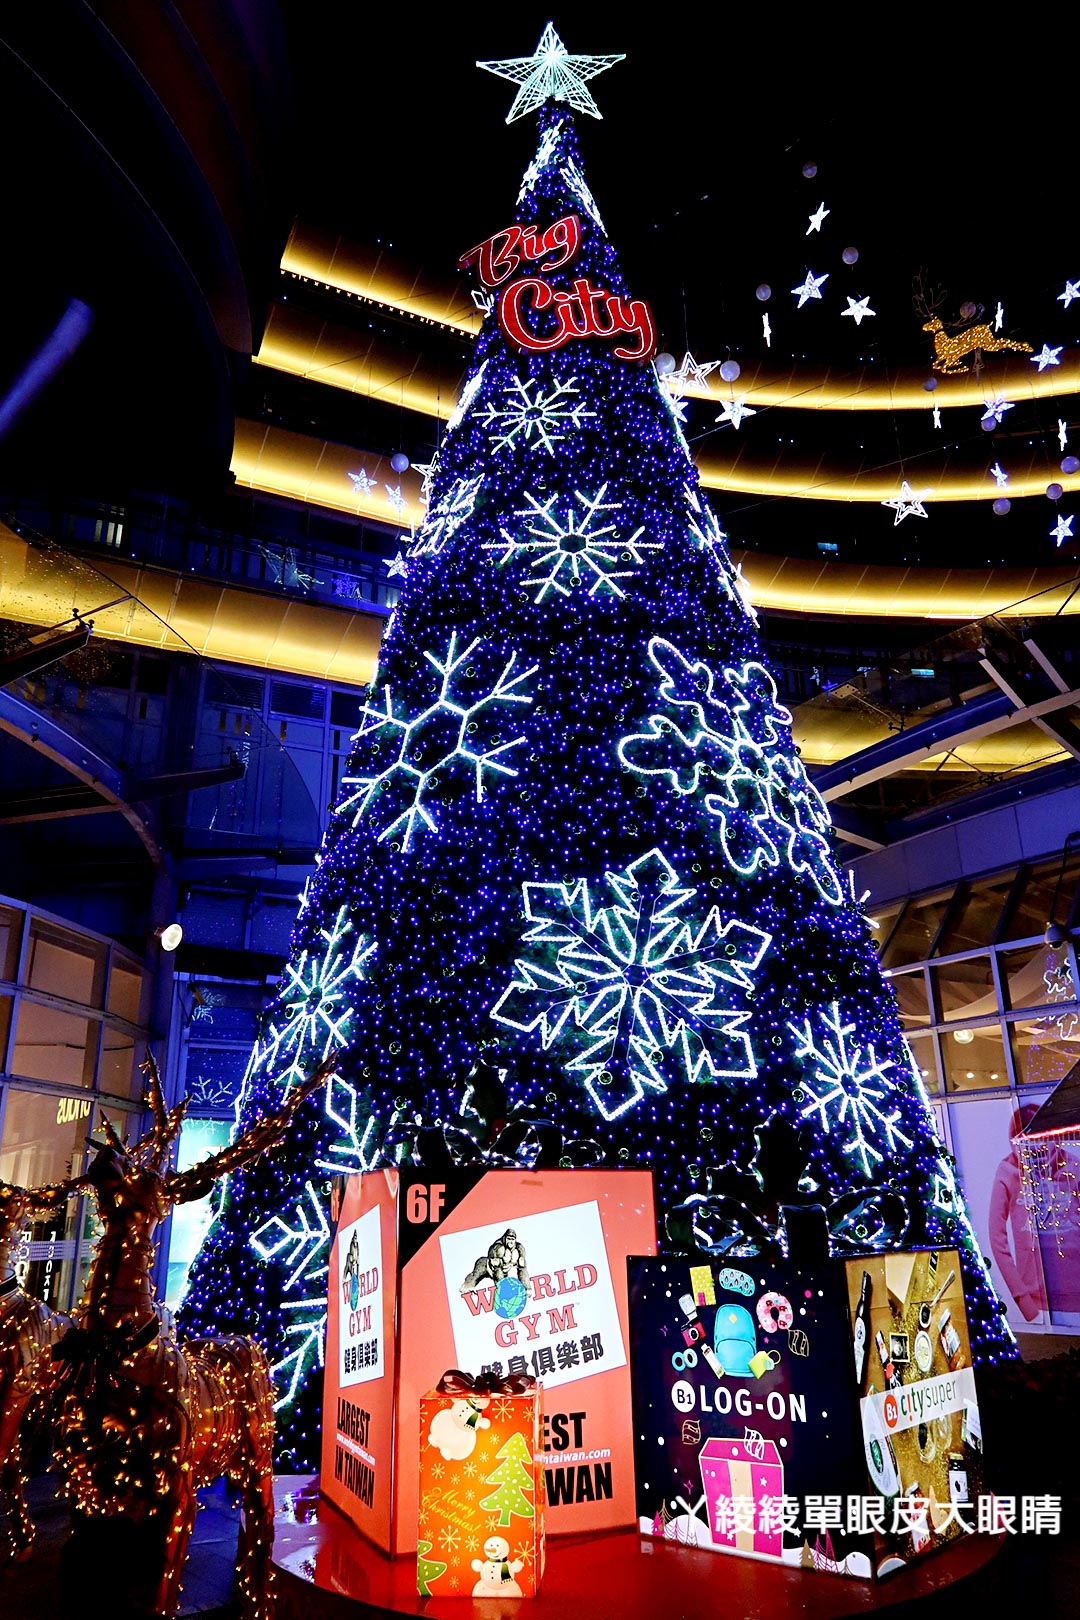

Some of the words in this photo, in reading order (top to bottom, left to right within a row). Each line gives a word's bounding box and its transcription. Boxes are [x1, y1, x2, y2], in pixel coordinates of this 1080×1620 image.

[456, 214, 581, 288] Big
[501, 277, 657, 361] City
[406, 1183, 446, 1224] 6F
[461, 1263, 598, 1317] WORLD
[349, 1305, 372, 1338] GYM
[494, 1304, 578, 1348] GYM
[337, 1396, 371, 1449] LARGEST
[676, 1389, 693, 1405] B1
[699, 1384, 807, 1423] LOG-ON
[335, 1445, 343, 1483] IN
[344, 1450, 375, 1509] TAIWAN
